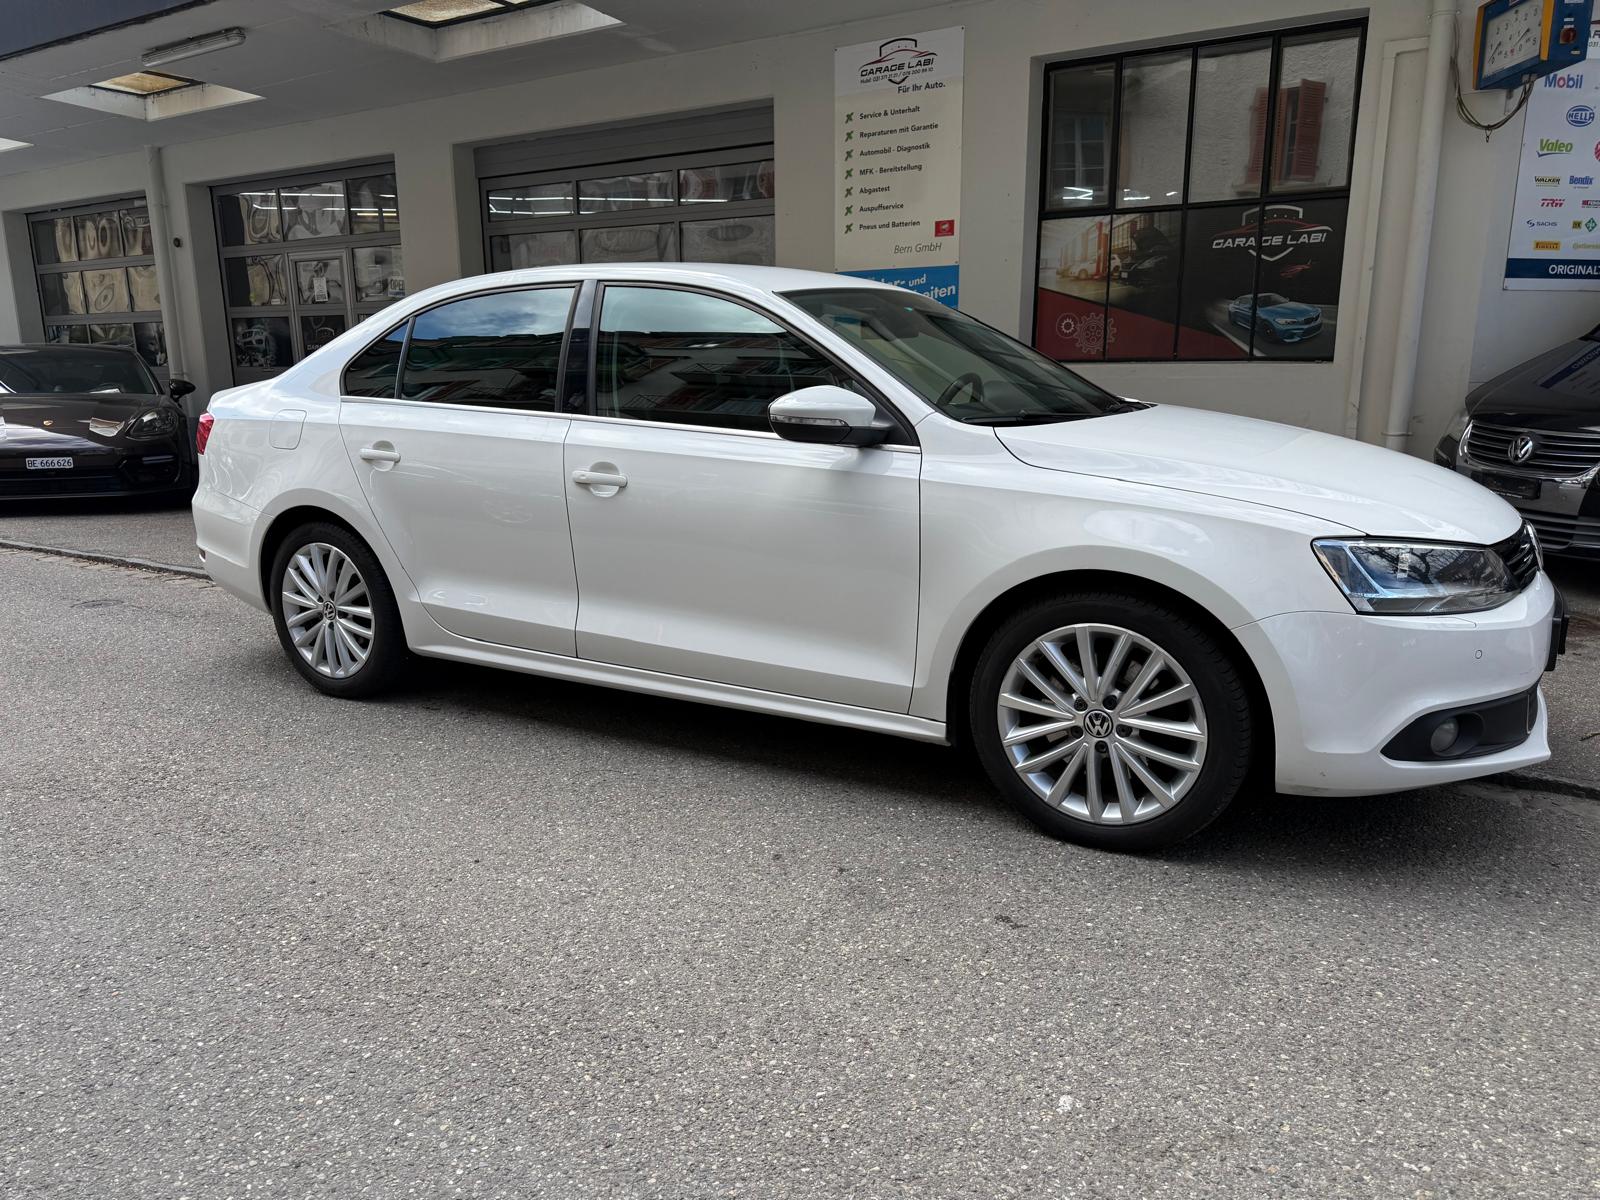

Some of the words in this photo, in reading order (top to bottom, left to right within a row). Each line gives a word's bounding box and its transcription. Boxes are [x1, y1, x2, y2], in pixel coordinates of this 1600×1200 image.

[861, 63, 905, 76] GARAGE
[908, 58, 934, 68] LABI
[1544, 74, 1584, 88] Mobil
[898, 86, 910, 94] Für
[860, 112, 882, 120] Service
[890, 106, 920, 116] Unterhalt
[1568, 112, 1594, 121] HELLA
[860, 128, 897, 139] Reparaturen
[911, 122, 938, 132] Garantie
[860, 147, 892, 157] Automobil
[896, 142, 930, 153] Diagnostik
[1540, 139, 1573, 152] Valeo
[879, 164, 922, 174] Bereitstellung
[1534, 176, 1560, 184] WALKER
[1569, 176, 1594, 185] Bendix
[859, 186, 890, 195] Abgastest
[859, 203, 904, 213] Auspuffservice
[1540, 198, 1565, 207] TRW
[1212, 236, 1283, 248] GARAGE
[1287, 233, 1327, 244] LABI
[894, 244, 913, 254] Bern
[914, 242, 942, 253] GmbH
[1548, 264, 1600, 275] ORIGINAL
[909, 274, 927, 286] und
